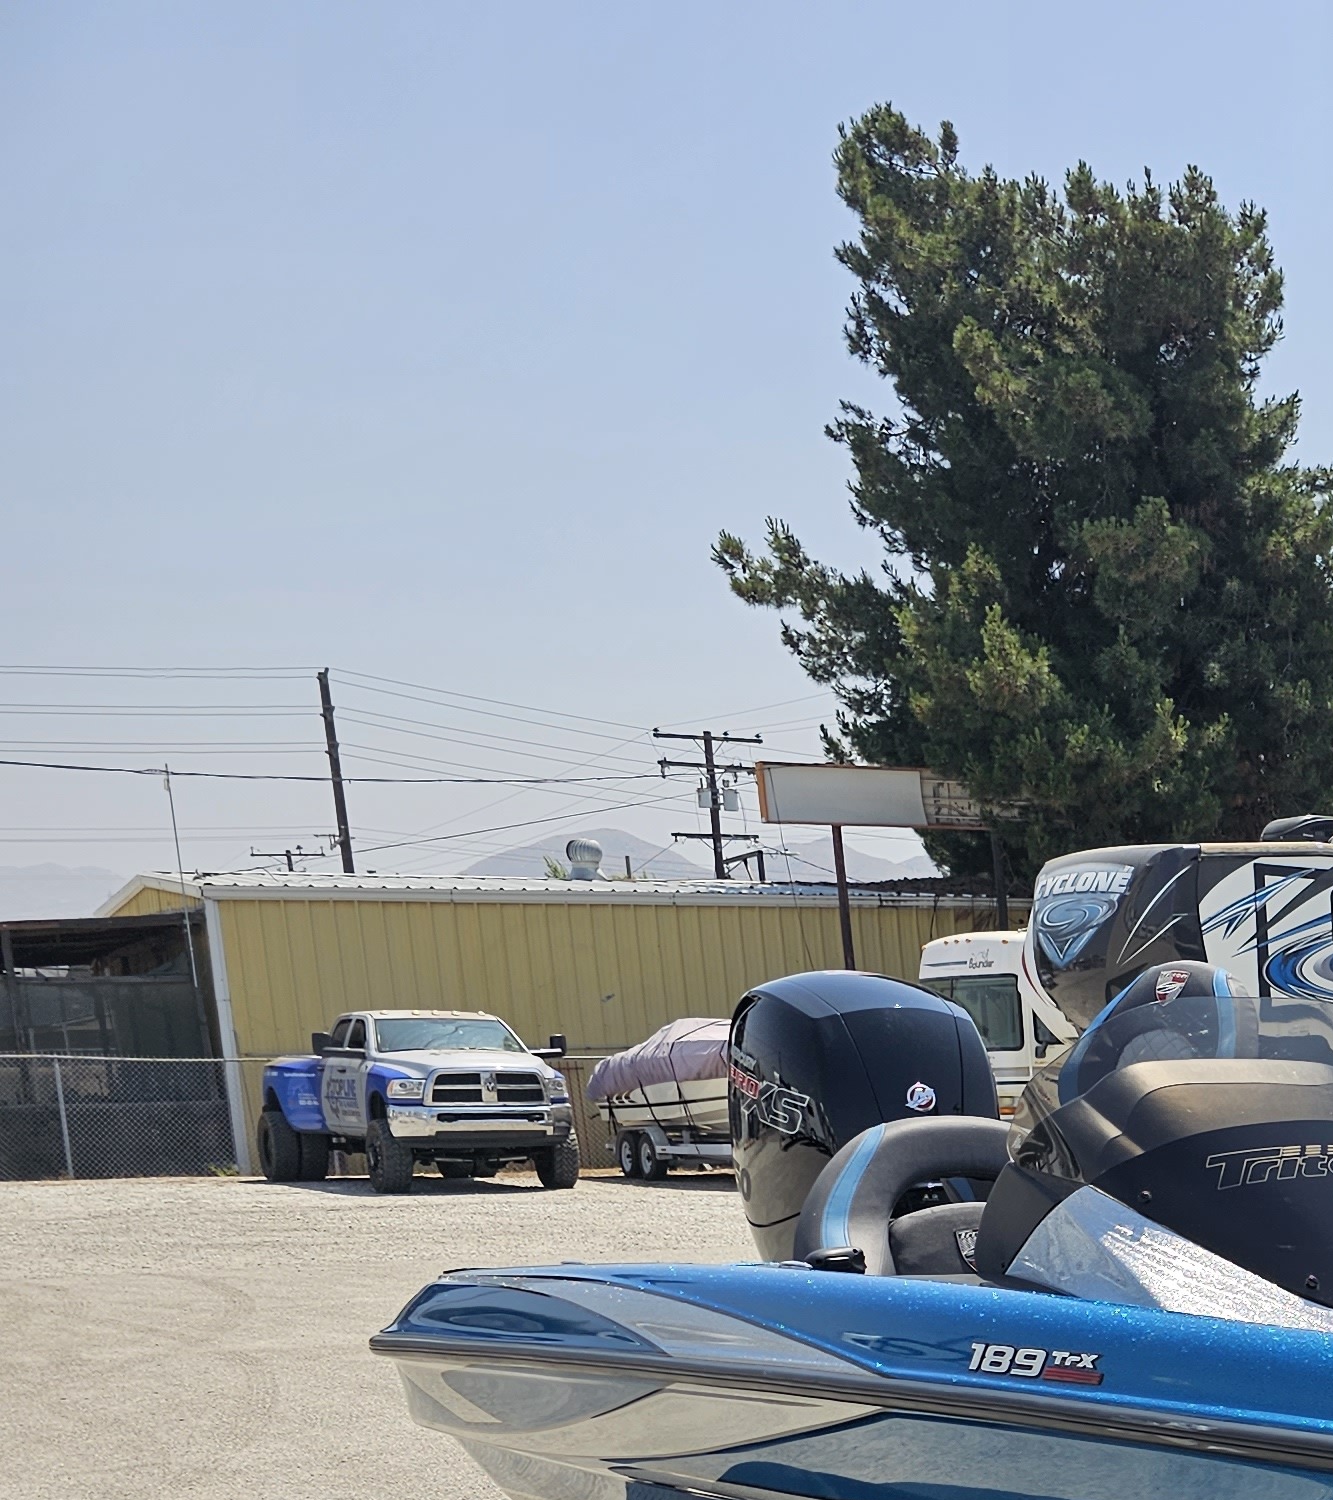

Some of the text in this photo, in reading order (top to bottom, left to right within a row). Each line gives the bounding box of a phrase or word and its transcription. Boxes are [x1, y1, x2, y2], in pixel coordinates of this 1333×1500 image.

[1036, 869, 1132, 901] CYCLONE
[742, 1081, 811, 1135] XS
[968, 1342, 1047, 1378] 189
